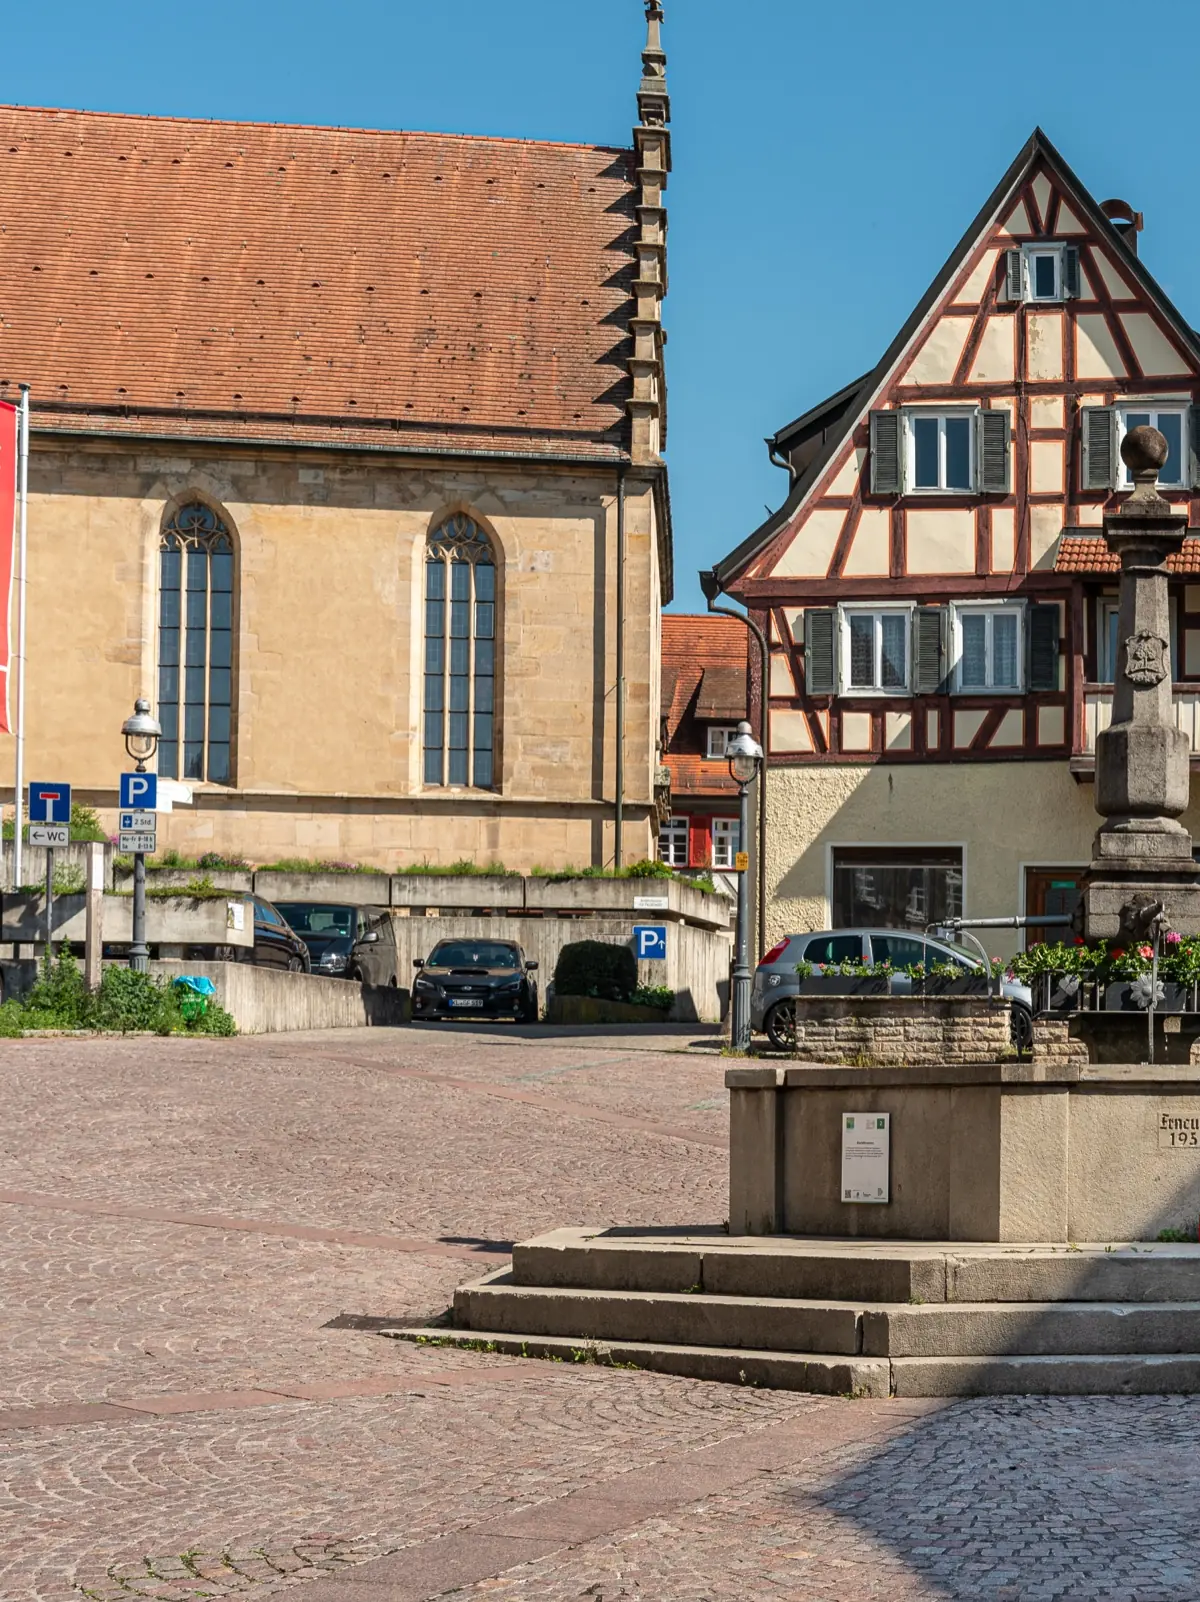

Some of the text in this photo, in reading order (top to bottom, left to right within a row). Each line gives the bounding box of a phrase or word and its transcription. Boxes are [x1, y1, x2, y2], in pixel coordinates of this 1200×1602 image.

[128, 777, 149, 805] P
[47, 831, 66, 841] WC
[640, 930, 659, 955] P
